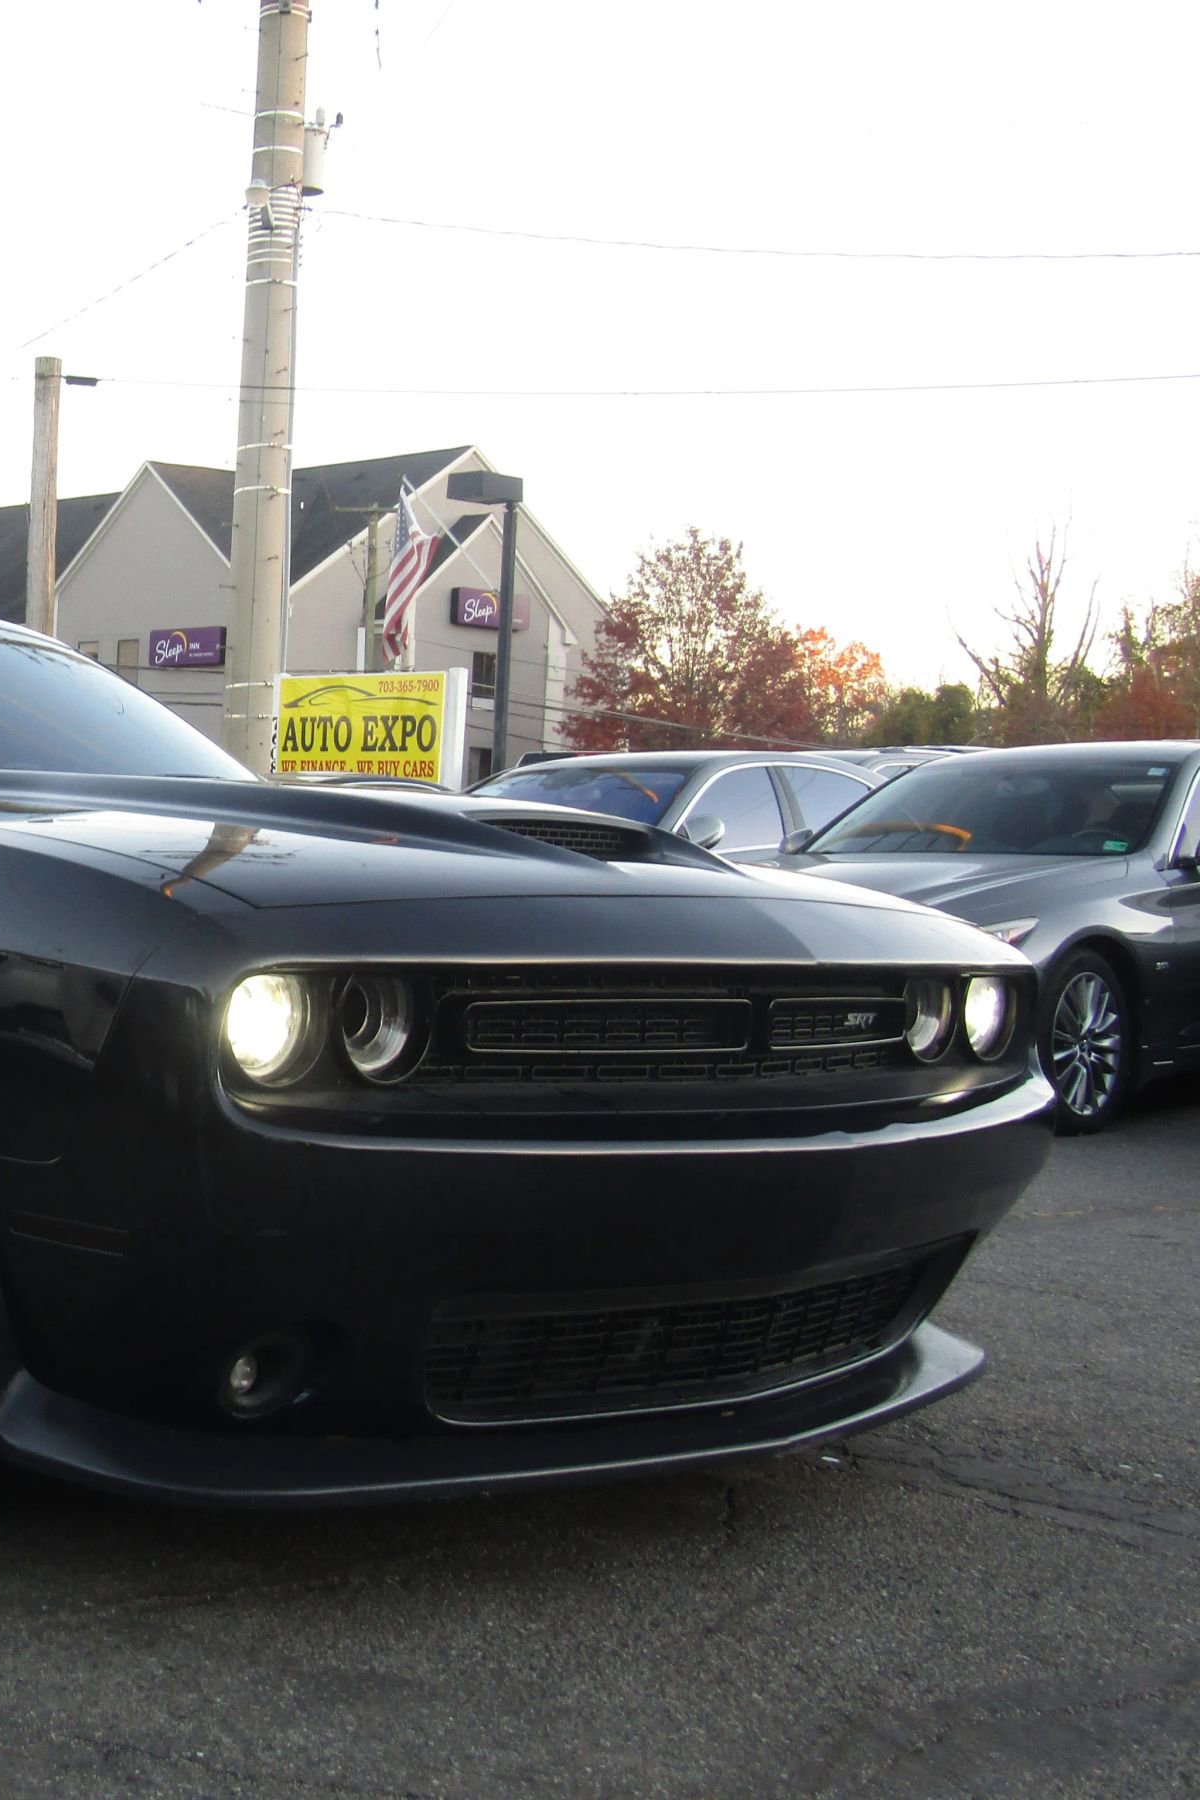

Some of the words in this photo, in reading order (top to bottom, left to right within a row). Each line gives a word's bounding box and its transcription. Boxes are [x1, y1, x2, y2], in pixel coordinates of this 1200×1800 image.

[464, 598, 494, 623] Sleep
[155, 639, 183, 664] Sleep
[189, 642, 200, 650] INN
[378, 680, 439, 693] 703-365-7900
[282, 716, 352, 752] AUTO
[361, 714, 437, 752] EXPO
[300, 760, 347, 772] FINANCE
[357, 760, 373, 774] WE
[378, 760, 400, 777] BUY
[403, 760, 434, 777] CARS
[844, 1012, 878, 1029] SRT
